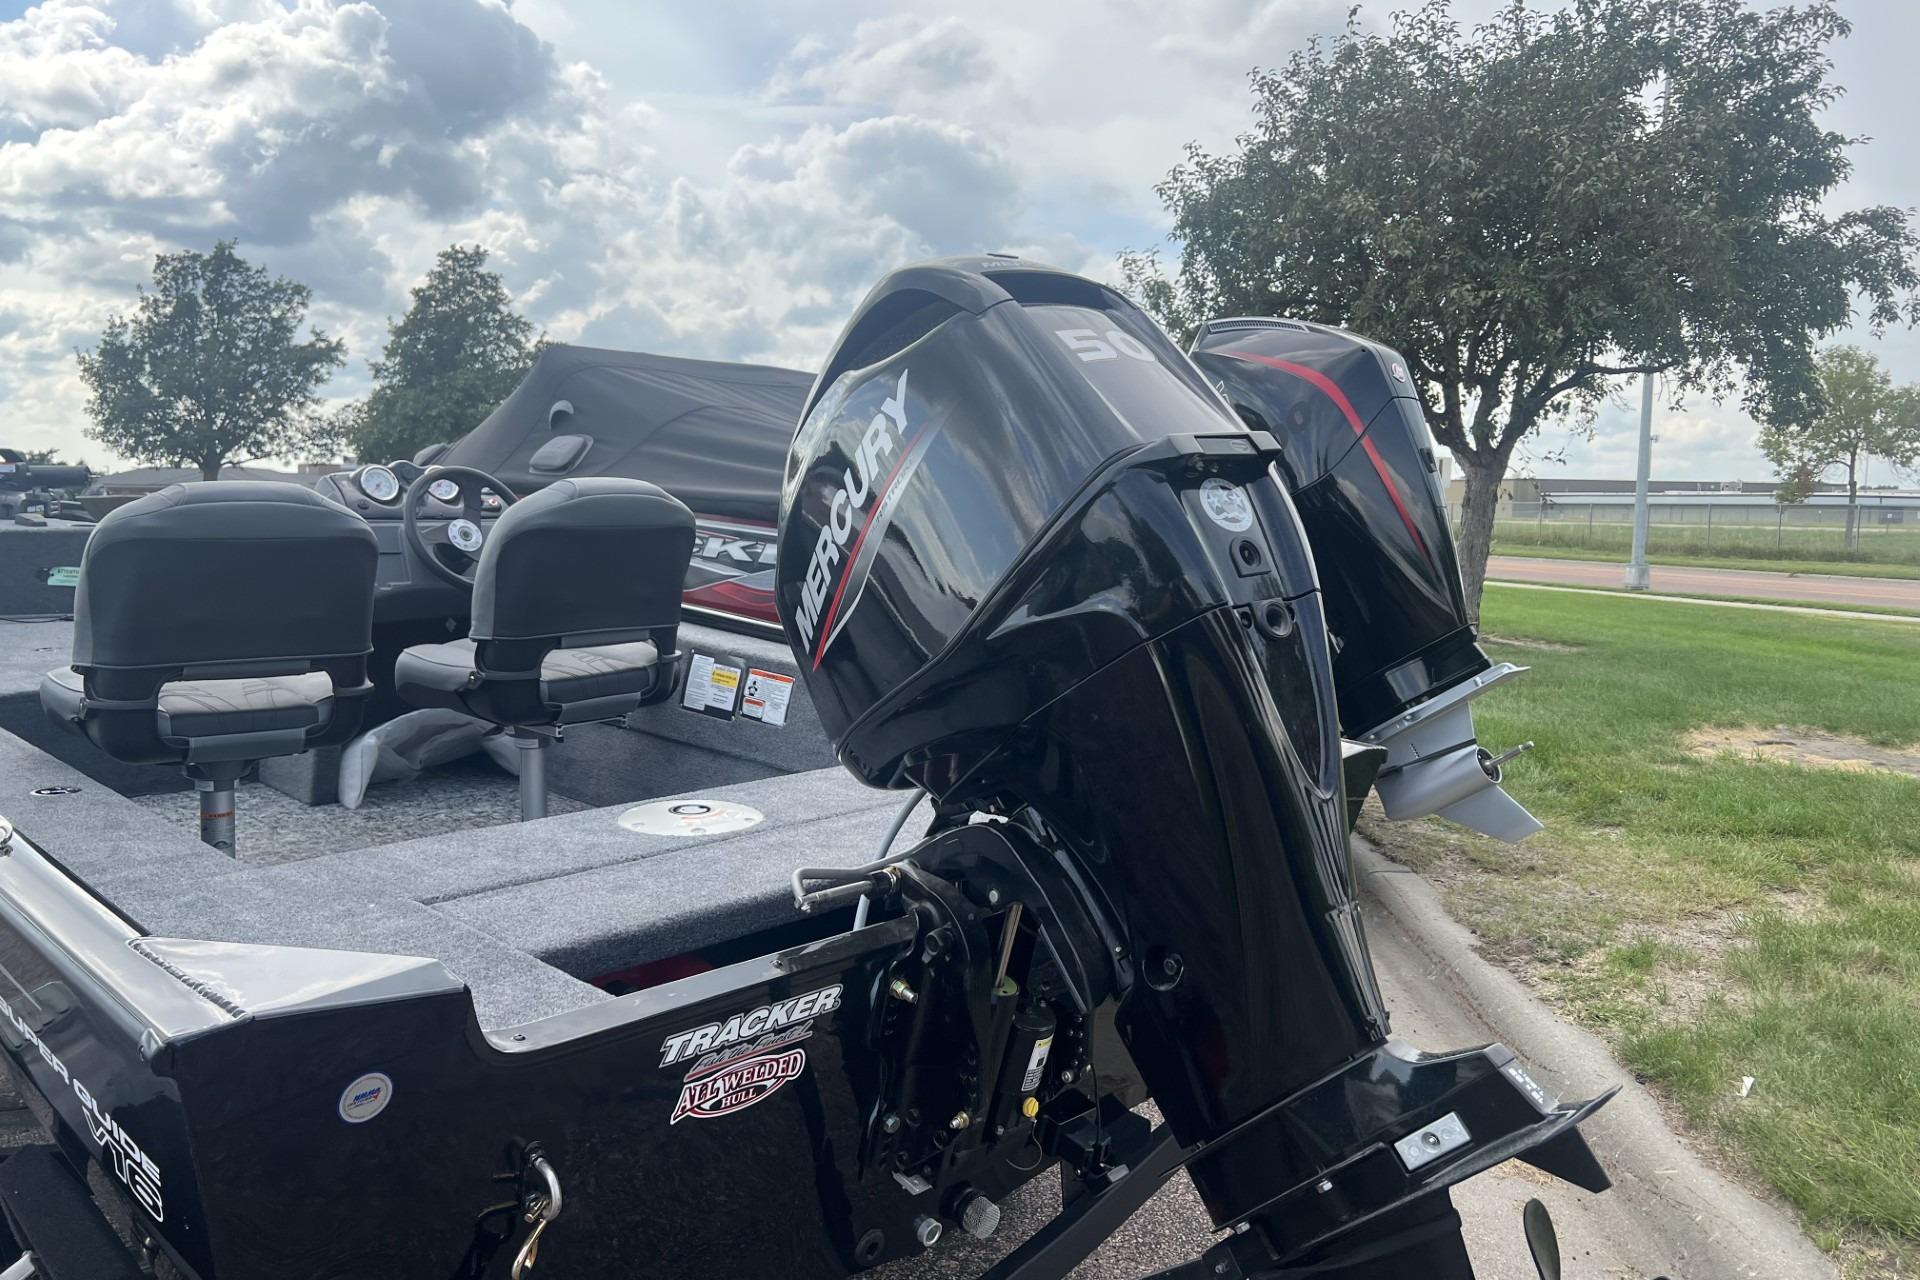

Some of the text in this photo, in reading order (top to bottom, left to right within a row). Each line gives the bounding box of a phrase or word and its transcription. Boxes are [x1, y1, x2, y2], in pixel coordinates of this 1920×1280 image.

[1055, 329, 1156, 362] 50
[795, 368, 908, 655] MERCURY
[664, 985, 843, 1064] TRACKER
[677, 1053, 801, 1116] ALL WELDED
[720, 1088, 757, 1109] HULL
[73, 1078, 161, 1187] GUIDE
[82, 1105, 163, 1223] V16
